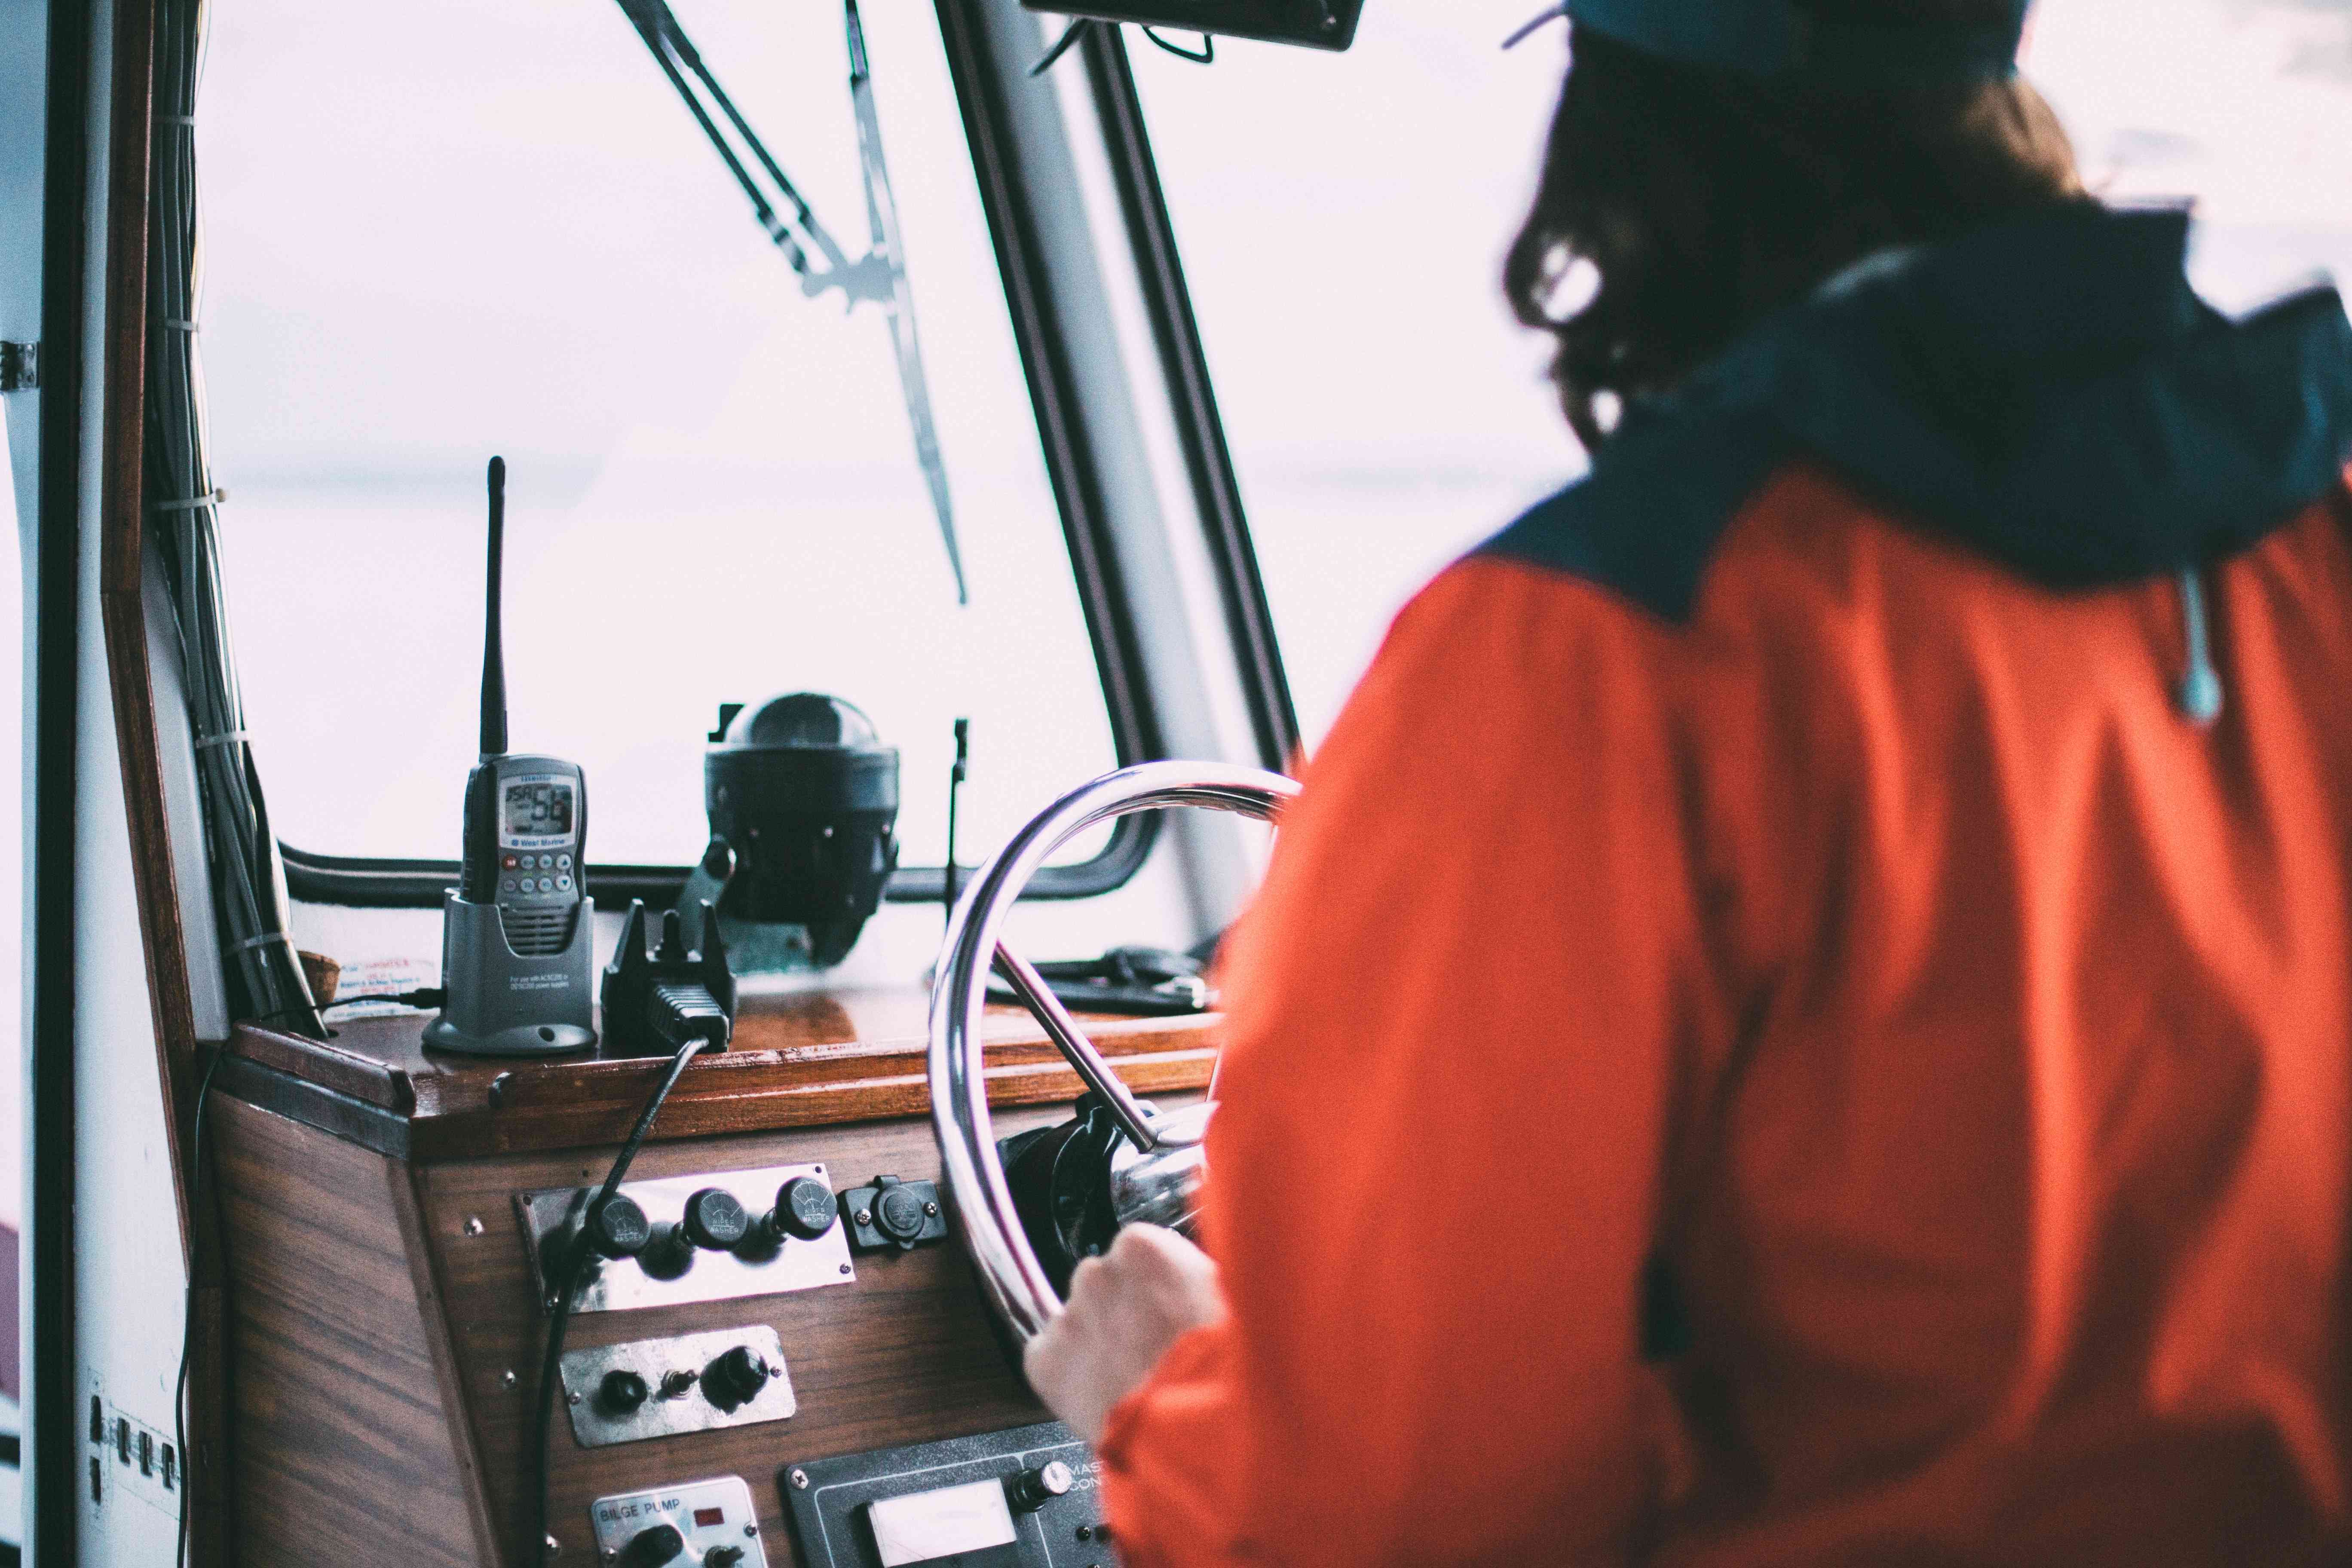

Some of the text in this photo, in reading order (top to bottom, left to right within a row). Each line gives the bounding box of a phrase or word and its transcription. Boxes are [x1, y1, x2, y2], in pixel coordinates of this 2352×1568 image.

[1069, 1462, 1102, 1475] MAS
[600, 1498, 680, 1522] BILGE PUMP
